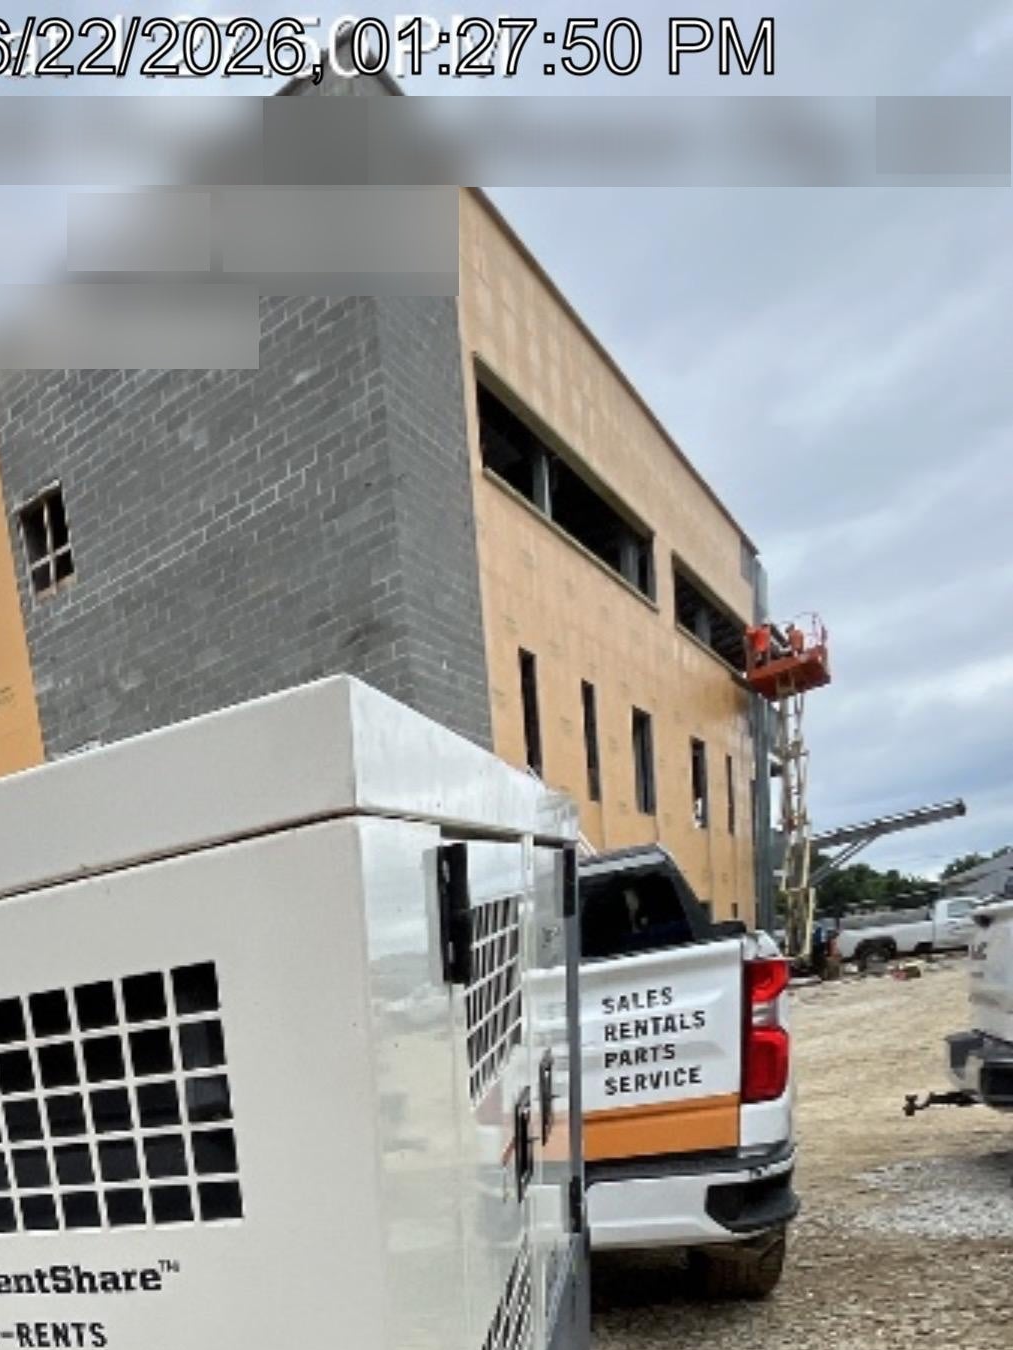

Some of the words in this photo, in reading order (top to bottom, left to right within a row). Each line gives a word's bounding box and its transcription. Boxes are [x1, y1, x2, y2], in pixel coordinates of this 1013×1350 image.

[601, 986, 673, 1015] SALES
[604, 1010, 706, 1042] RENTALS
[604, 1043, 676, 1069] PARTS
[604, 1065, 703, 1096] SERVICE
